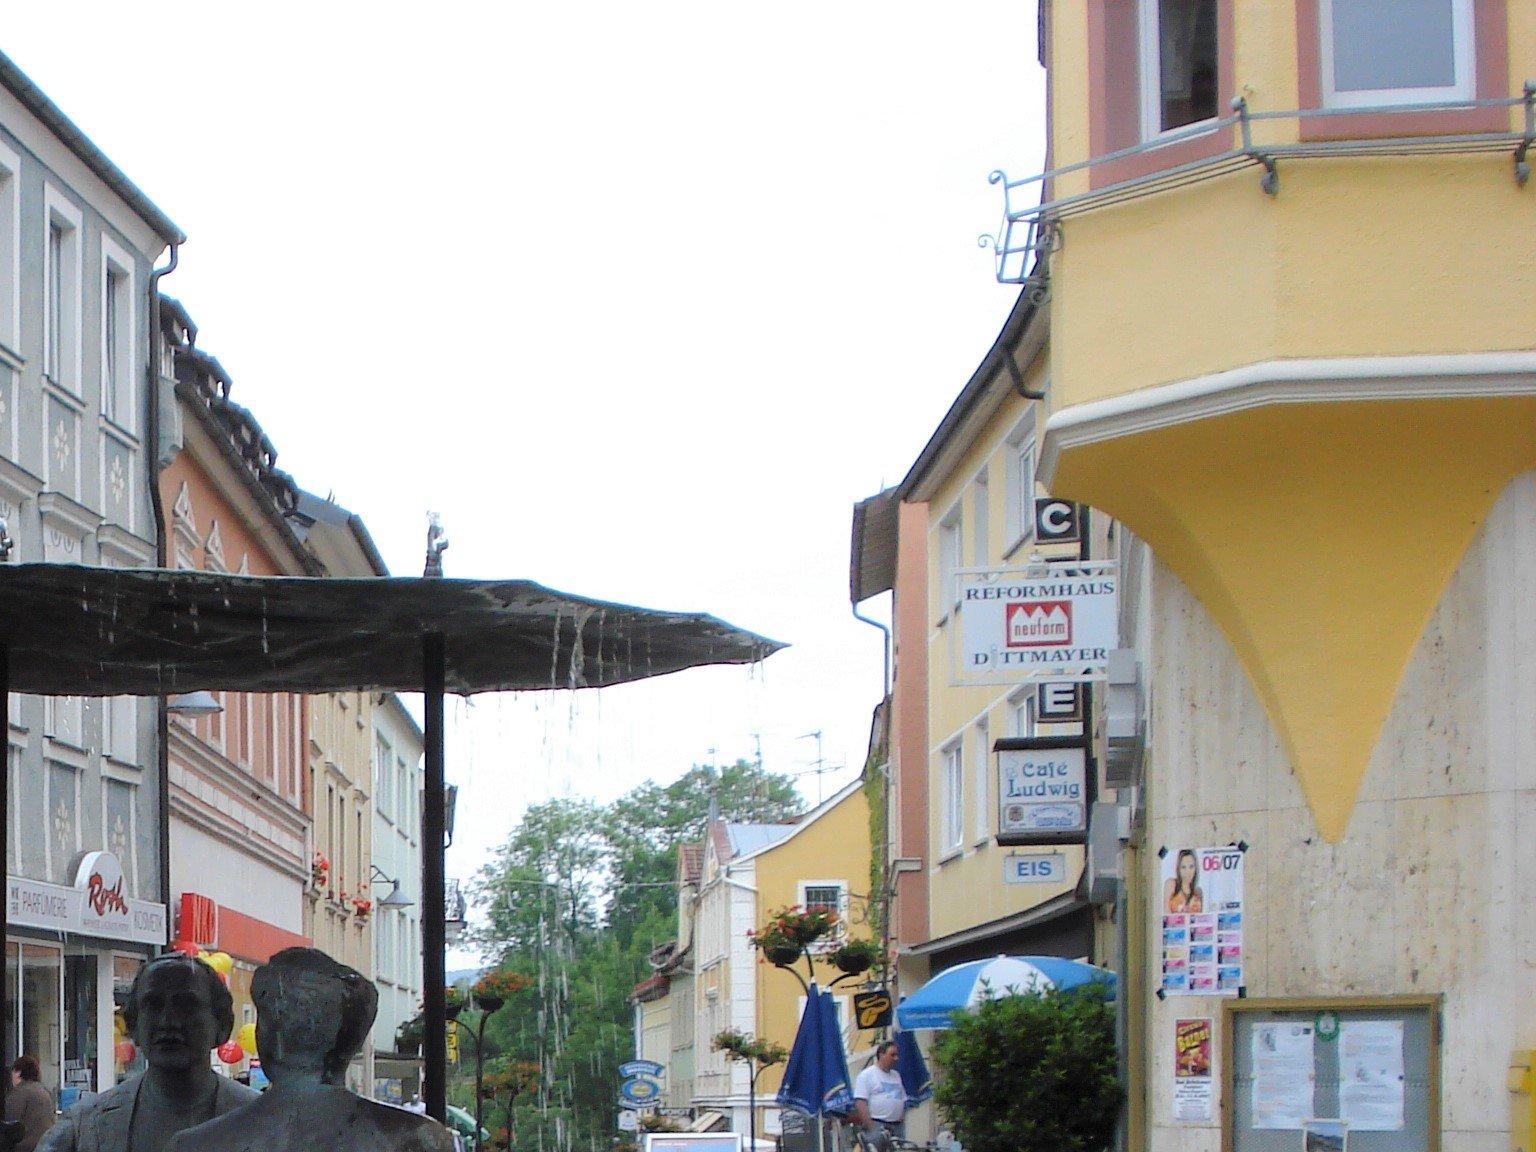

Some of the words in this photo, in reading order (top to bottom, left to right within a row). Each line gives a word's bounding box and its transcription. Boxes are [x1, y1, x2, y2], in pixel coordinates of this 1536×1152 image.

[966, 582, 1114, 600] REFORMHAUS
[1014, 618, 1064, 636] neuform
[974, 648, 1106, 665] DTTMAYER
[1007, 779, 1079, 798] Ludwig
[1017, 861, 1052, 877] EIS
